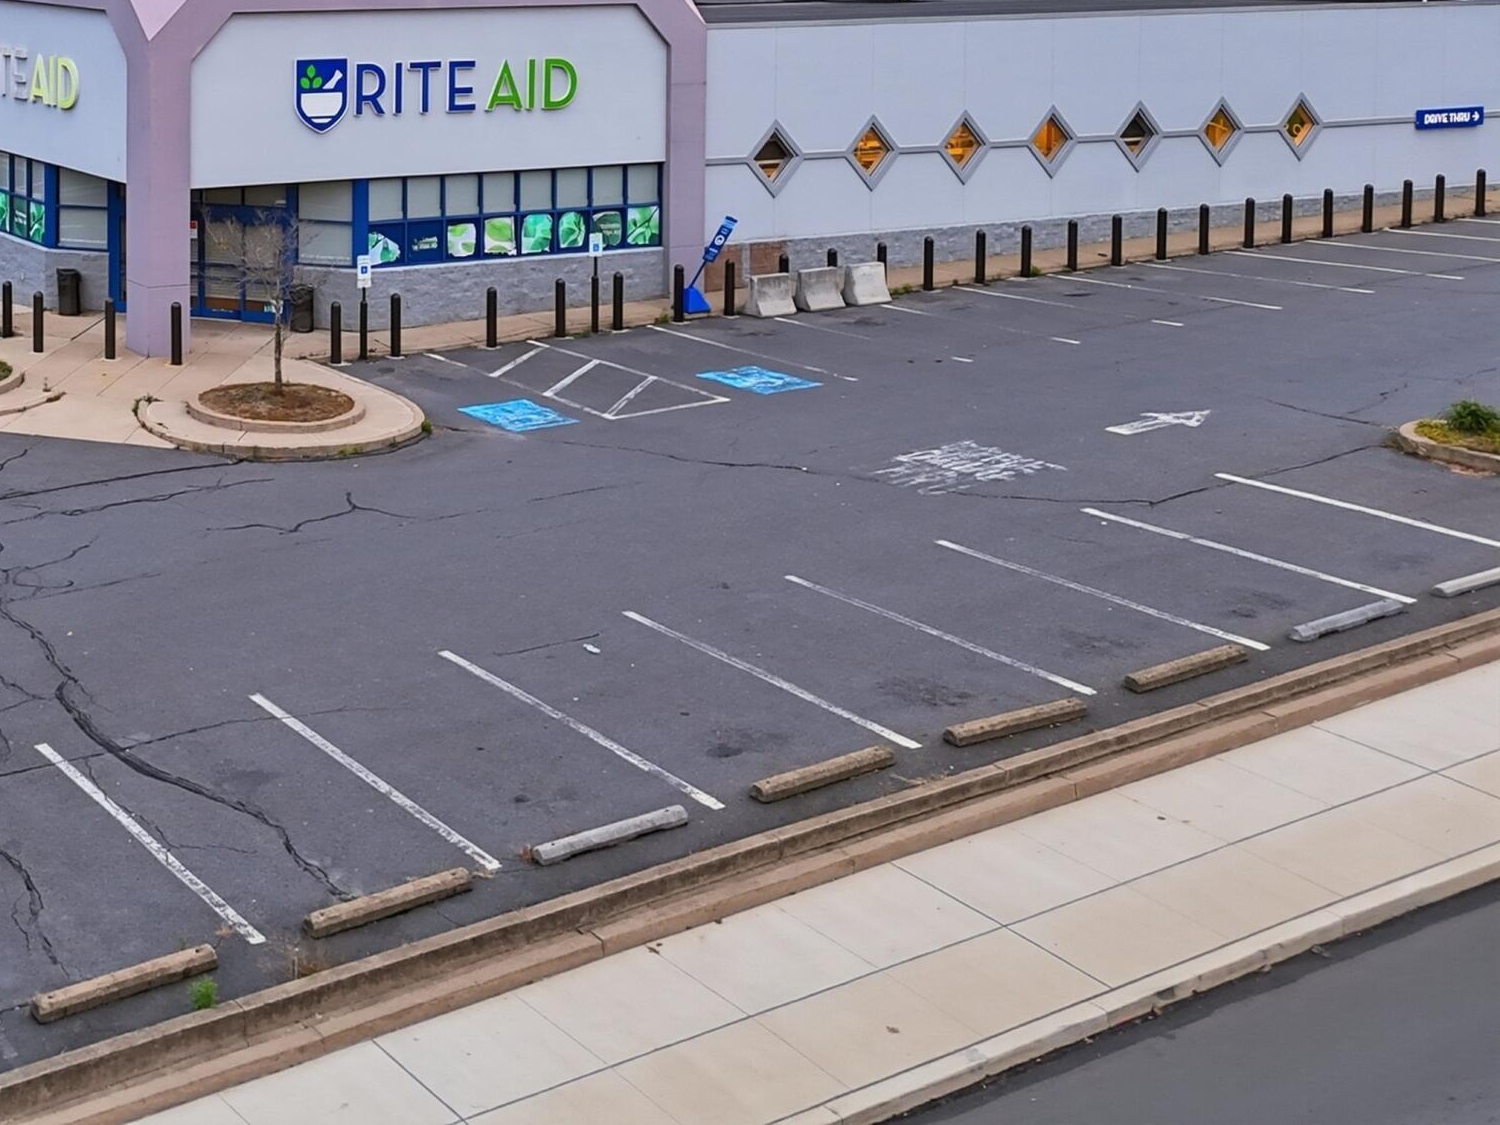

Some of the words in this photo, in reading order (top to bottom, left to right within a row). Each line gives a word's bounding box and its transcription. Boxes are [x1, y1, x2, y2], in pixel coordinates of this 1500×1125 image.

[30, 52, 80, 111] AID
[353, 59, 477, 117] RITE
[484, 57, 579, 112] AID
[1423, 112, 1449, 125] DRIVE
[1449, 110, 1471, 124] THRU
